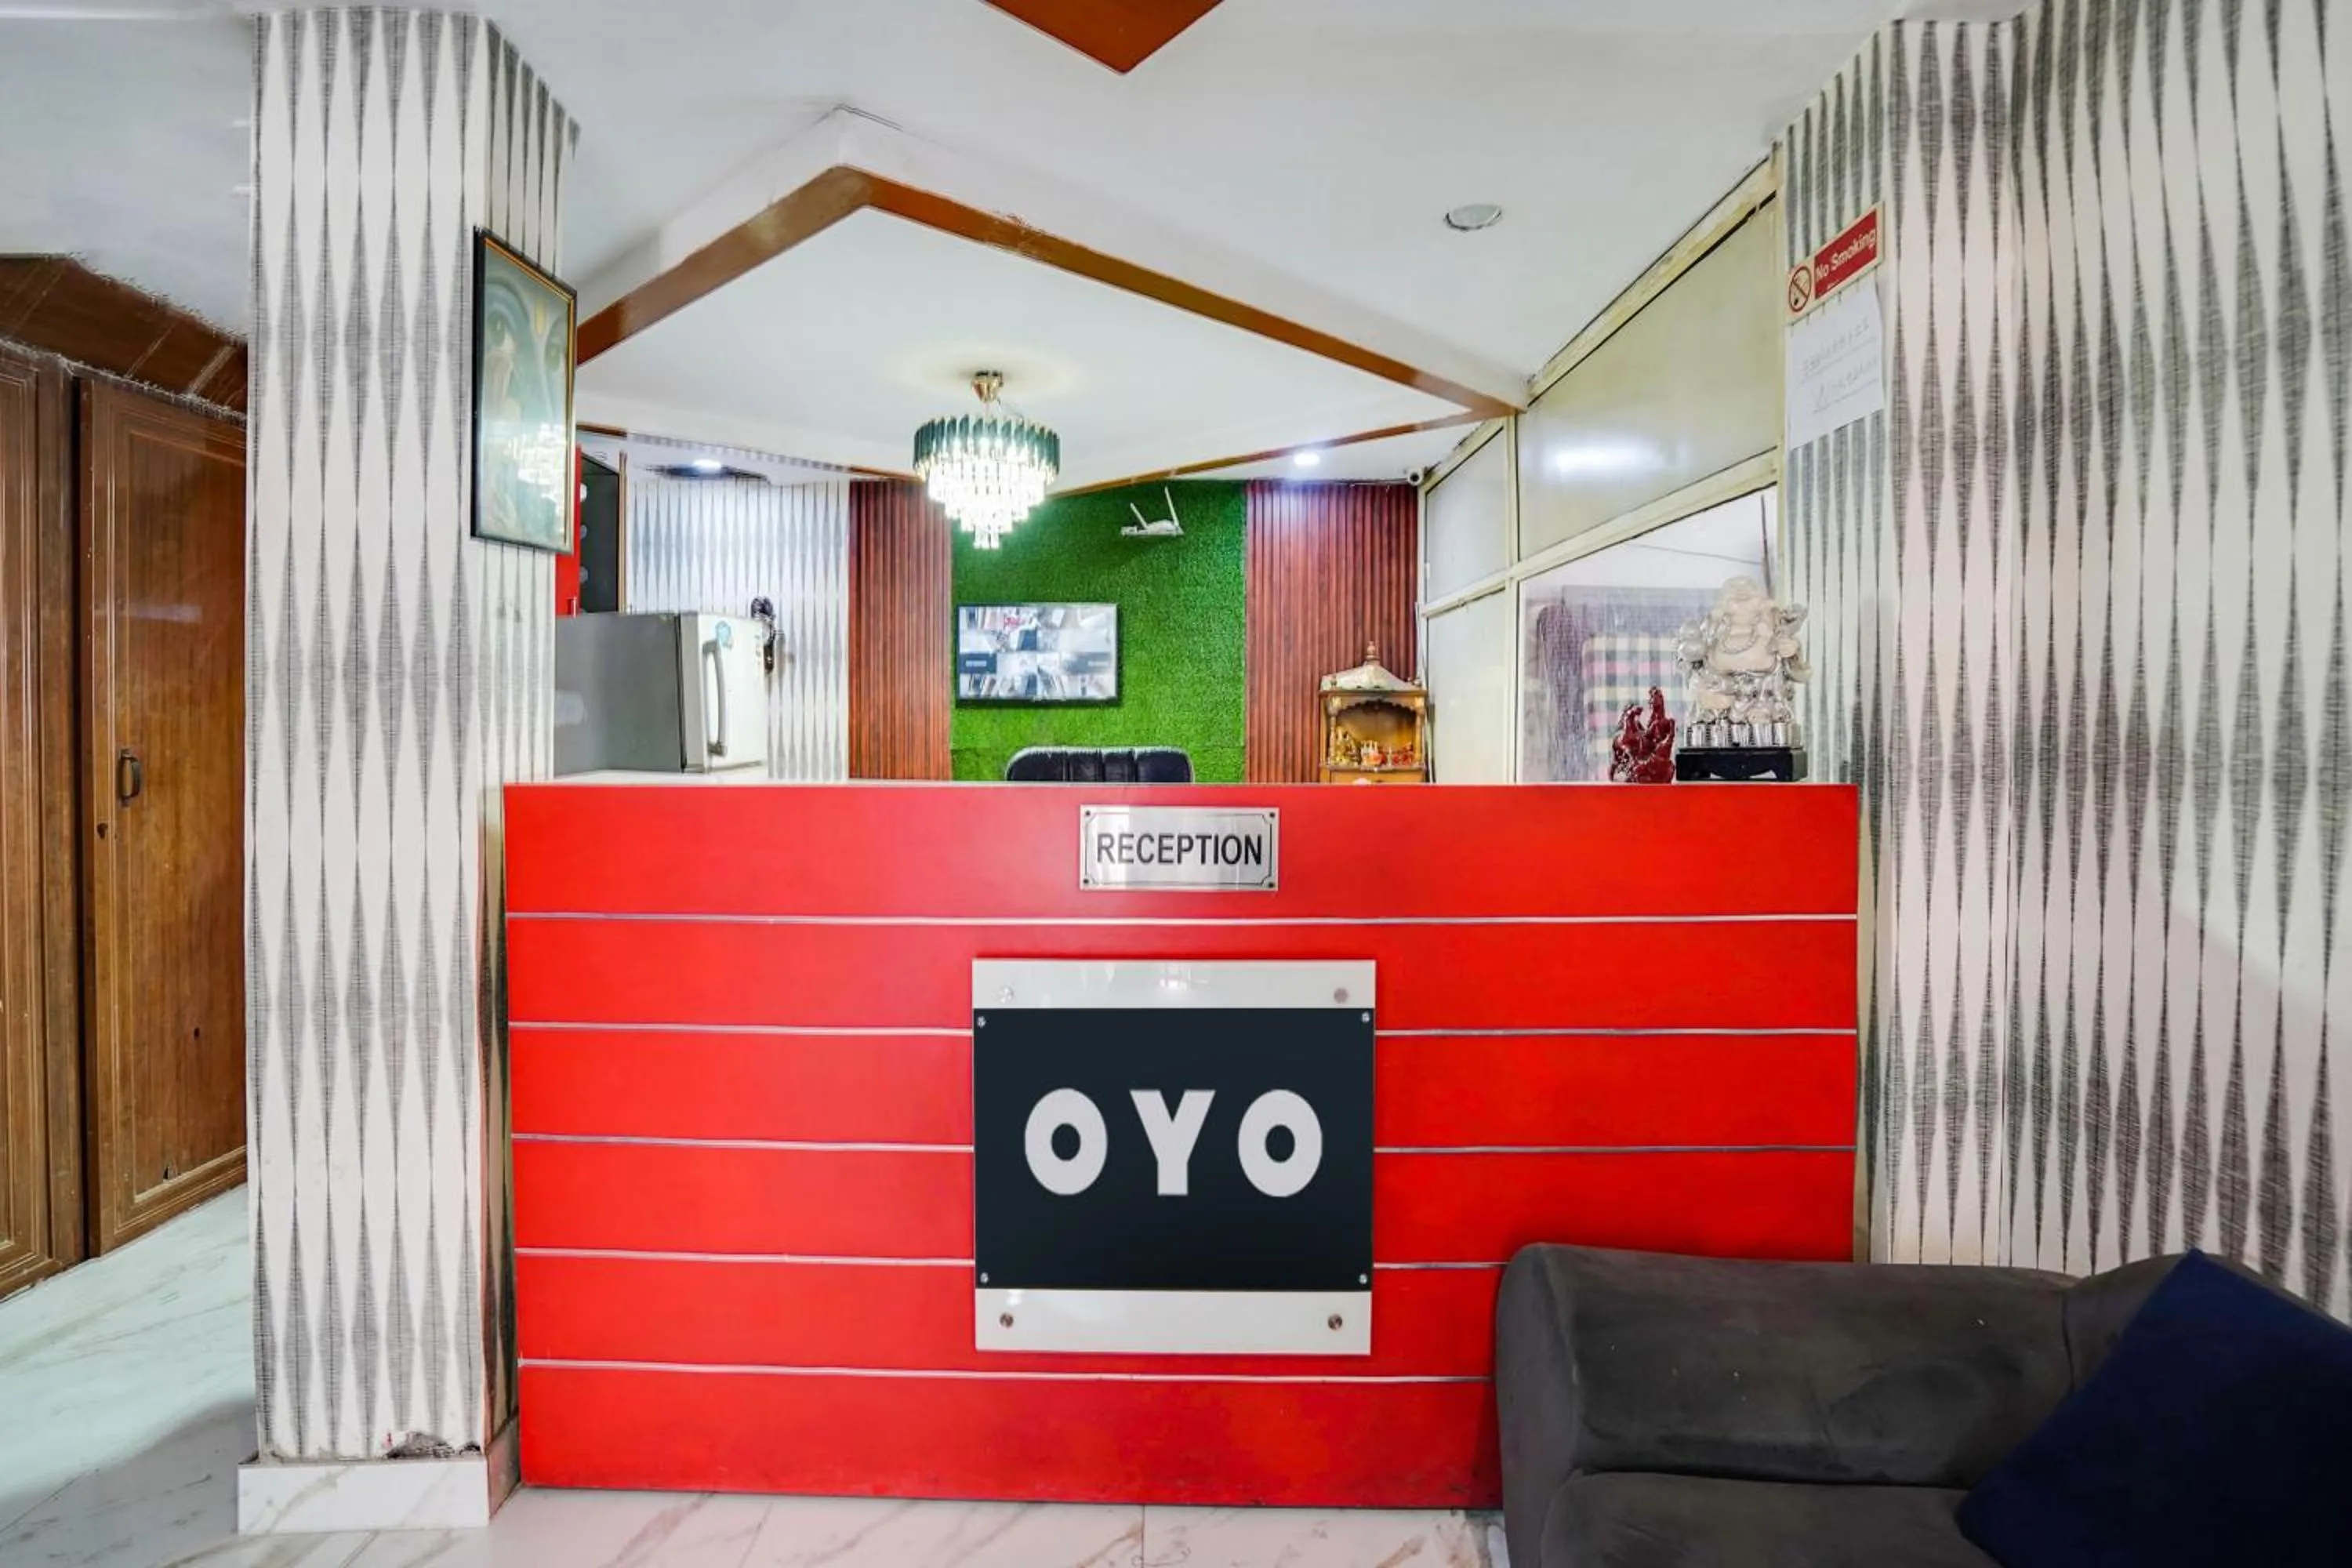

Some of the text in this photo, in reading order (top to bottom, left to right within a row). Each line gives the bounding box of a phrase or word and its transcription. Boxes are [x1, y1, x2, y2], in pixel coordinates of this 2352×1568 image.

[1815, 228, 1876, 281] No Smoking
[1096, 833, 1263, 866] RECEPTION
[1024, 1087, 1323, 1197] OYO
